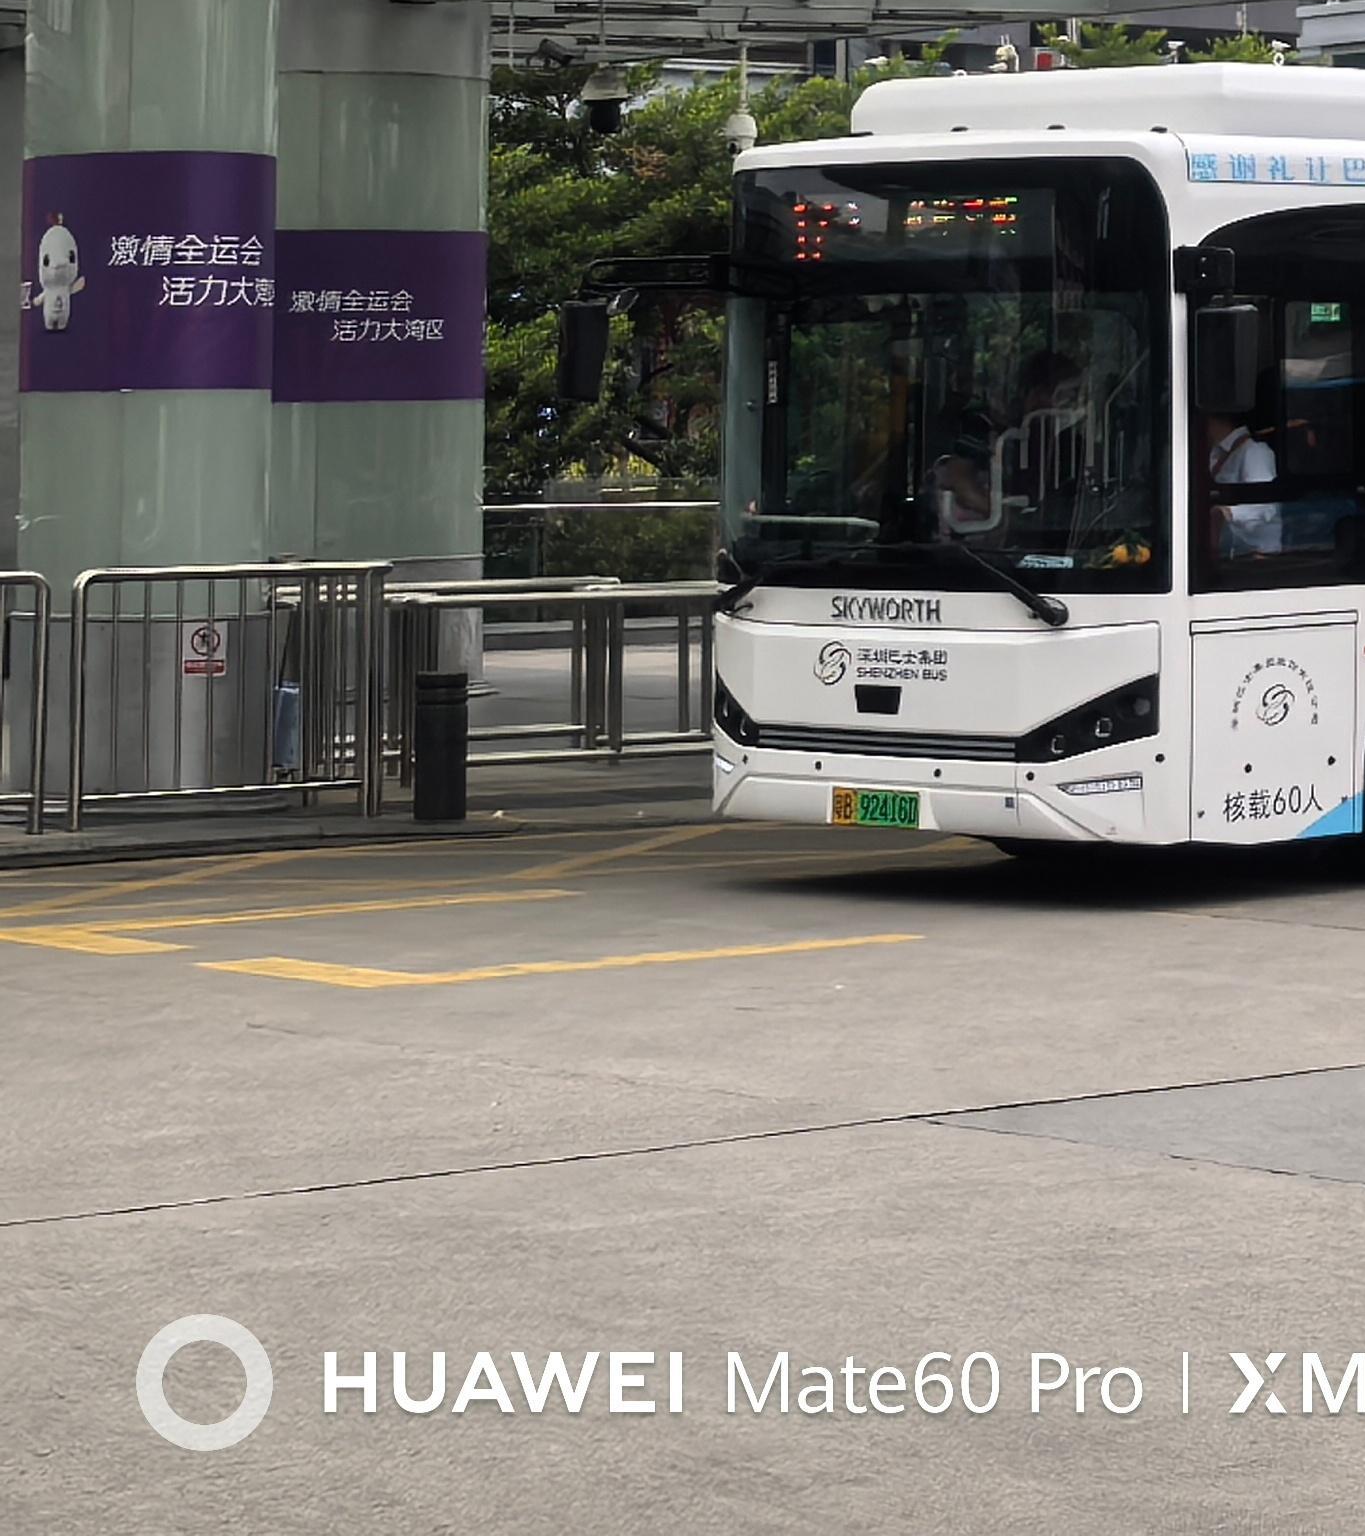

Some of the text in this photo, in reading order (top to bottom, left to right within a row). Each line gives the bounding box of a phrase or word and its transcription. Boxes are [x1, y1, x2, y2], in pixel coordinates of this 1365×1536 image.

[108, 234, 264, 267] 激情全运会
[331, 318, 445, 342] 活力大湾区
[830, 595, 942, 624] SKYWORTH
[1223, 783, 1323, 823] 核载60人
